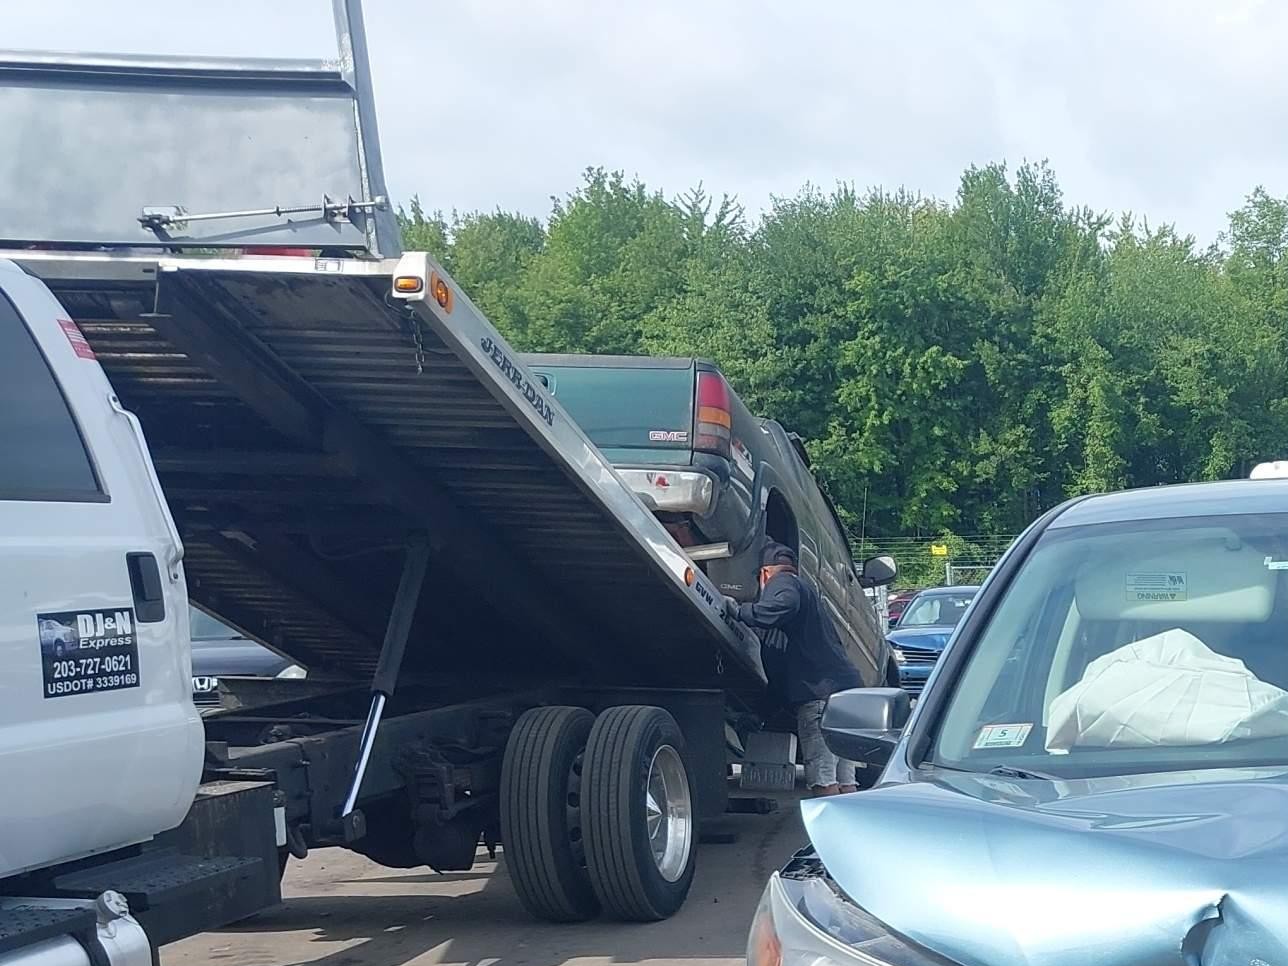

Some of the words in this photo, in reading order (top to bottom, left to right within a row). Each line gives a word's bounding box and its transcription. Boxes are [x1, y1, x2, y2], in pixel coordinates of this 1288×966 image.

[481, 337, 555, 427] JERR-DAN
[649, 430, 688, 441] GMC
[695, 581, 714, 606] GVW
[720, 583, 744, 591] GMC
[77, 611, 132, 638] DJ&N
[79, 636, 132, 650] Express
[53, 654, 131, 679] 203-727-0621
[48, 678, 94, 695] USDOT#
[96, 673, 137, 689] 3339169
